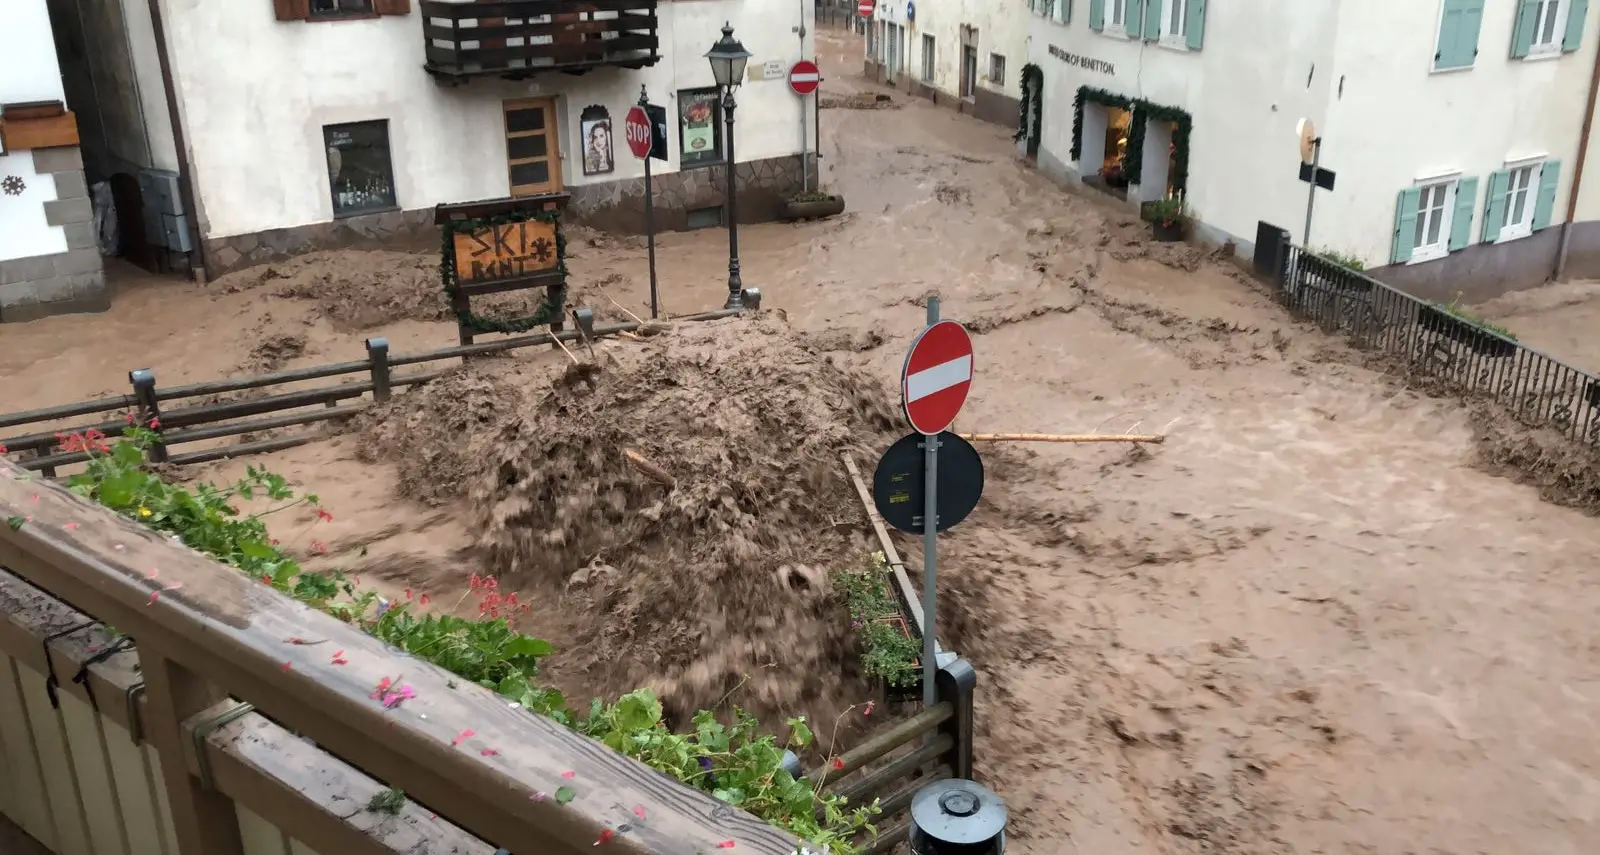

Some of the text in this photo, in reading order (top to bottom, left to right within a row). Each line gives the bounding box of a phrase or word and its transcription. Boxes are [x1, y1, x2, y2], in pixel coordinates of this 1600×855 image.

[1070, 54, 1080, 66] OF
[626, 121, 650, 144] STOP
[471, 223, 527, 257] SKI
